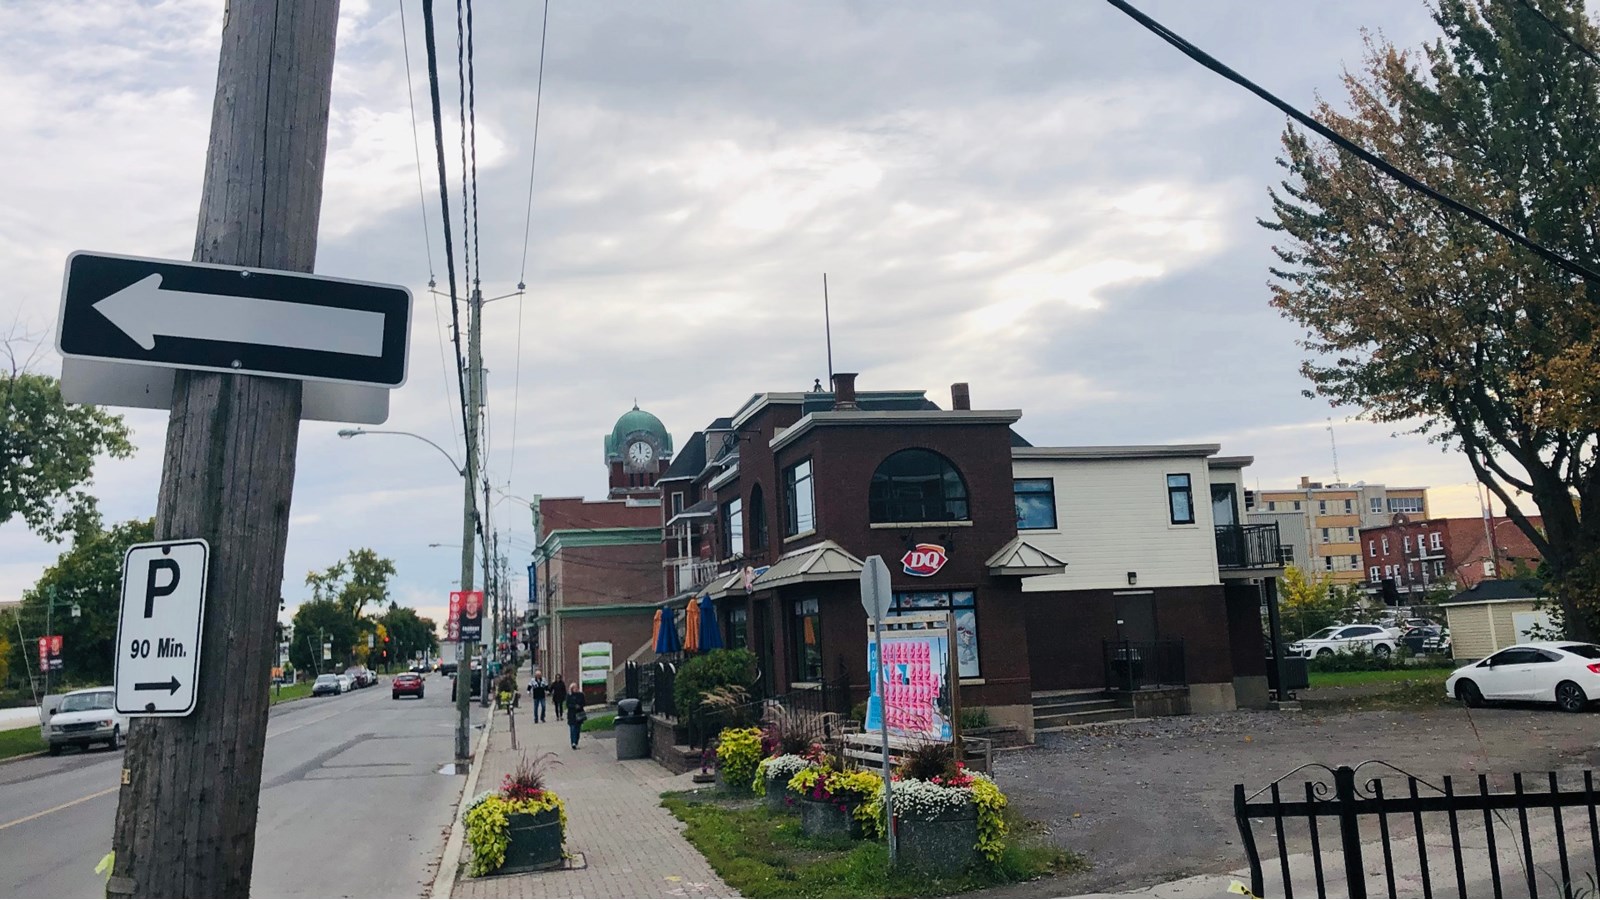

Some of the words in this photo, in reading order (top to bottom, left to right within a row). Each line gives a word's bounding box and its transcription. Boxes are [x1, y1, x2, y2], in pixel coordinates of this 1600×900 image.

[911, 552, 939, 569] DQ
[144, 559, 180, 618] P
[130, 639, 150, 659] 90
[157, 638, 186, 658] Min.
